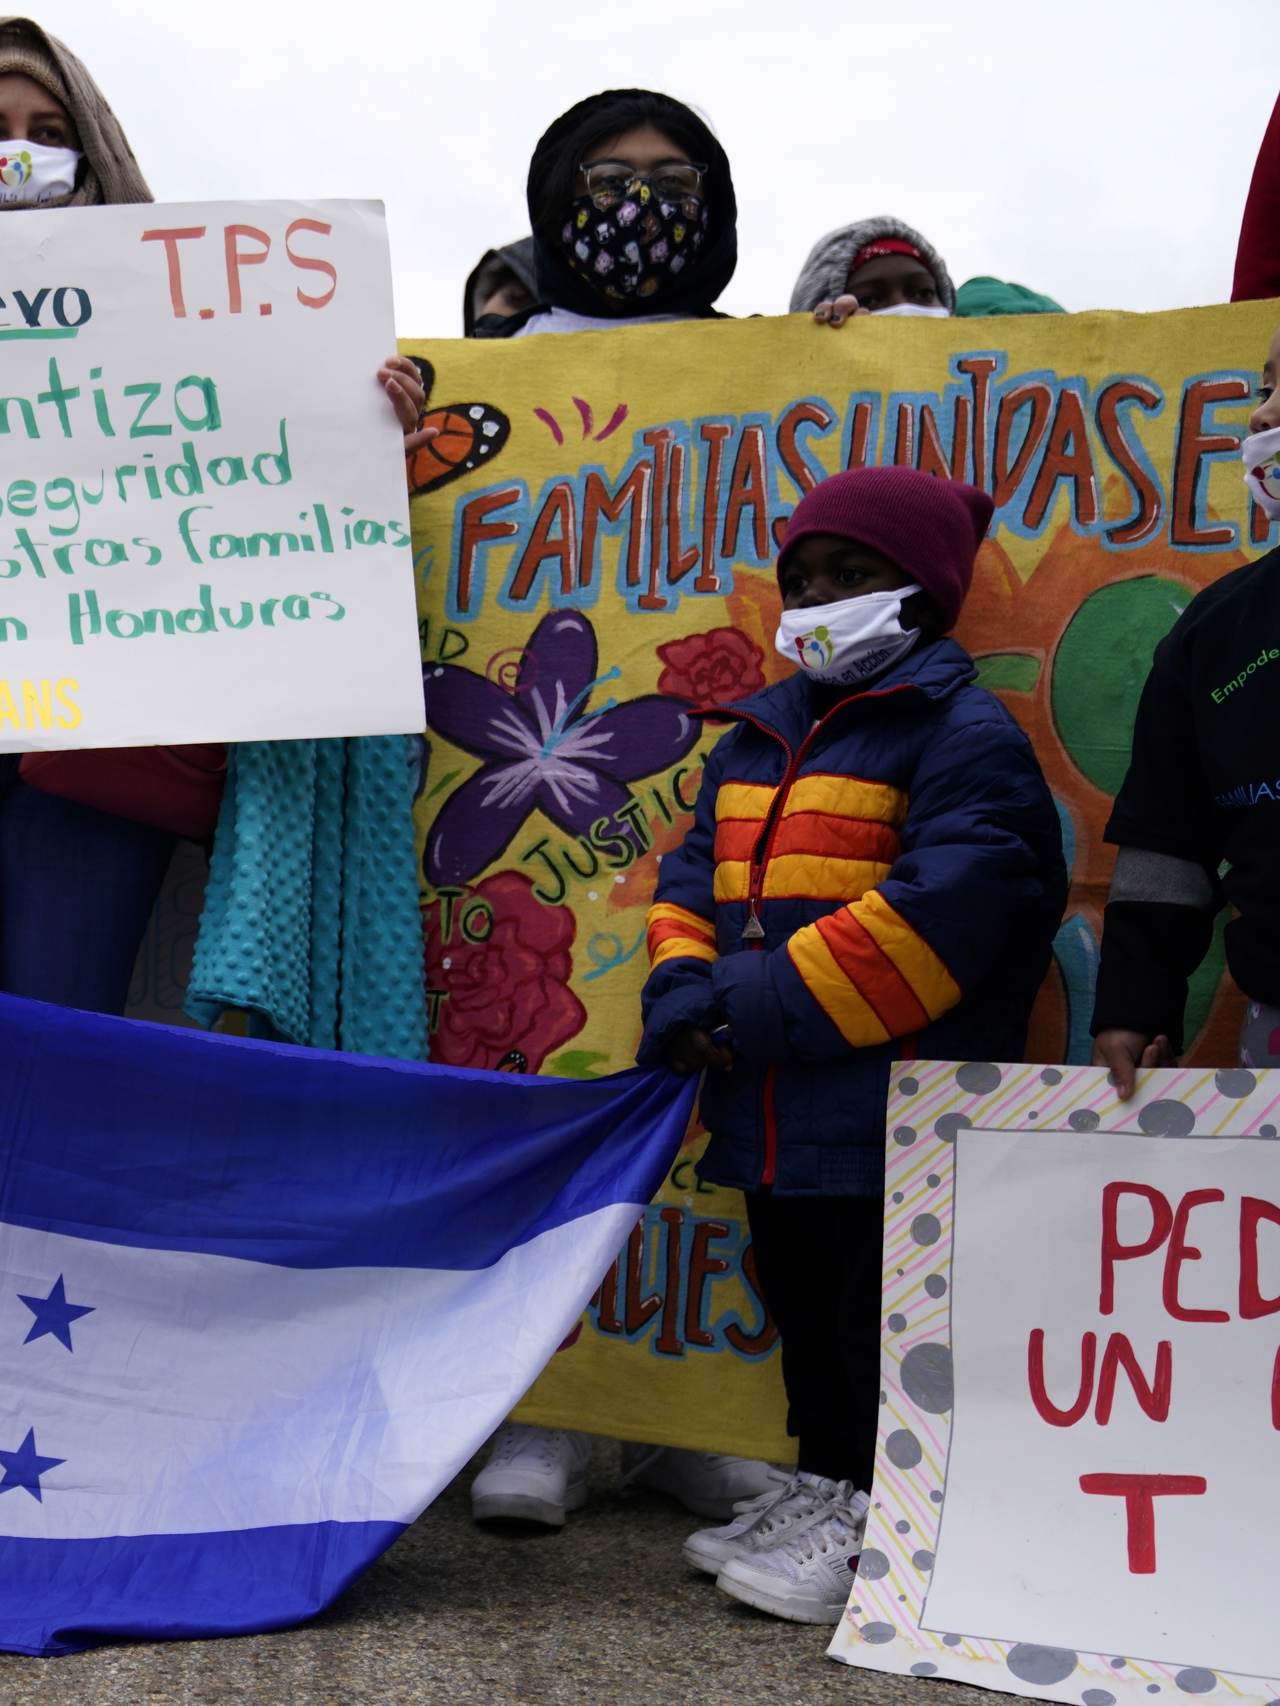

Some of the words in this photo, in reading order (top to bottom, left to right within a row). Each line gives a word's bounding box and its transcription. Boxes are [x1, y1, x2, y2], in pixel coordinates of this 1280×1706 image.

[141, 218, 339, 321] T.P.S
[67, 583, 346, 645] Honduras
[841, 669, 859, 683] en
[1210, 648, 1280, 704] Empode
[521, 752, 709, 904] JUSTIC
[1028, 1328, 1173, 1428] UN
[1079, 1472, 1208, 1575] T
